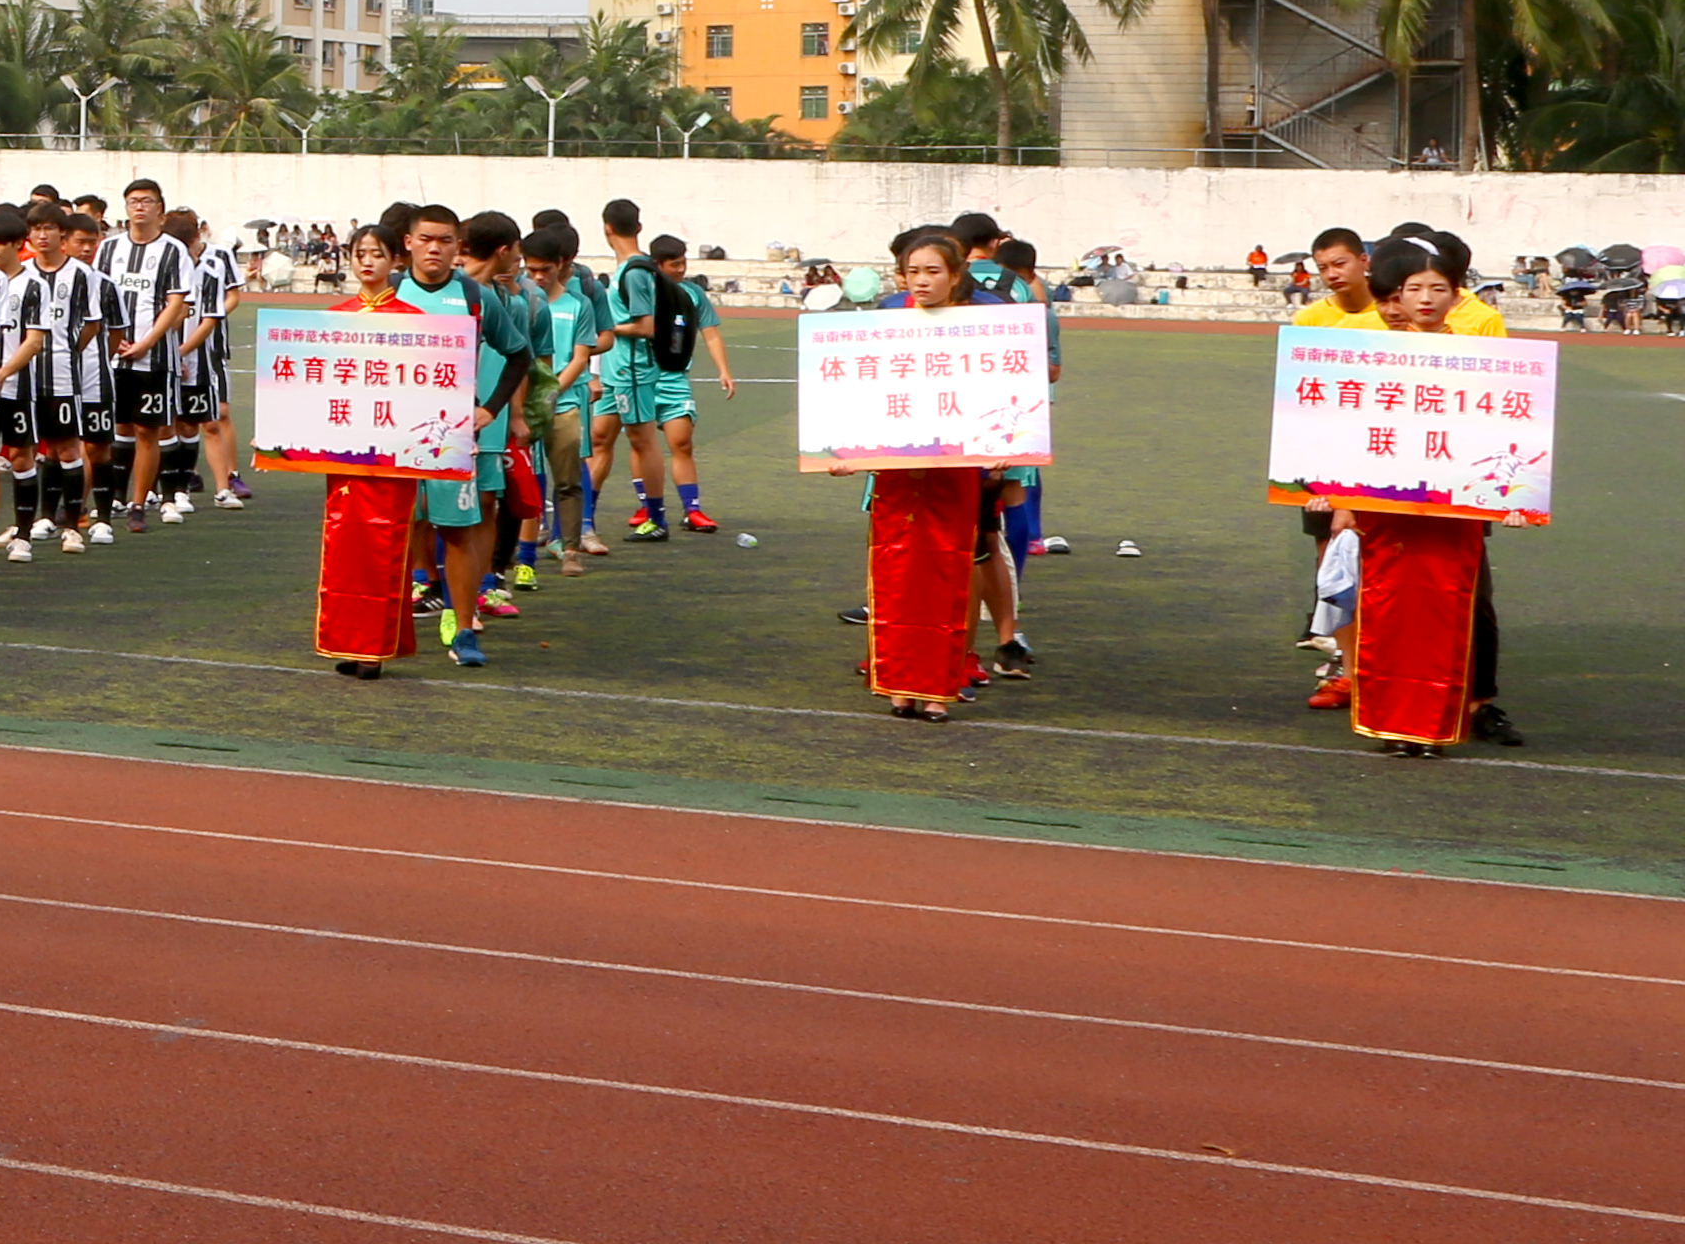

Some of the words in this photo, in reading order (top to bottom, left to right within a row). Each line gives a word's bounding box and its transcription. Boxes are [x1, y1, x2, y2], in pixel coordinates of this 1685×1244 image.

[117, 274, 151, 292] Jeep
[272, 355, 459, 389] 体育学院16级
[819, 348, 1030, 382] 体育学院15级
[140, 393, 164, 414] 23
[188, 394, 208, 415] 25
[885, 391, 963, 419] 联队
[1295, 376, 1534, 419] 体育学院14级
[14, 412, 27, 434] 3
[59, 402, 71, 424] 0
[88, 410, 111, 433] 36
[328, 398, 398, 427] 联队
[1366, 427, 1454, 460] 联队
